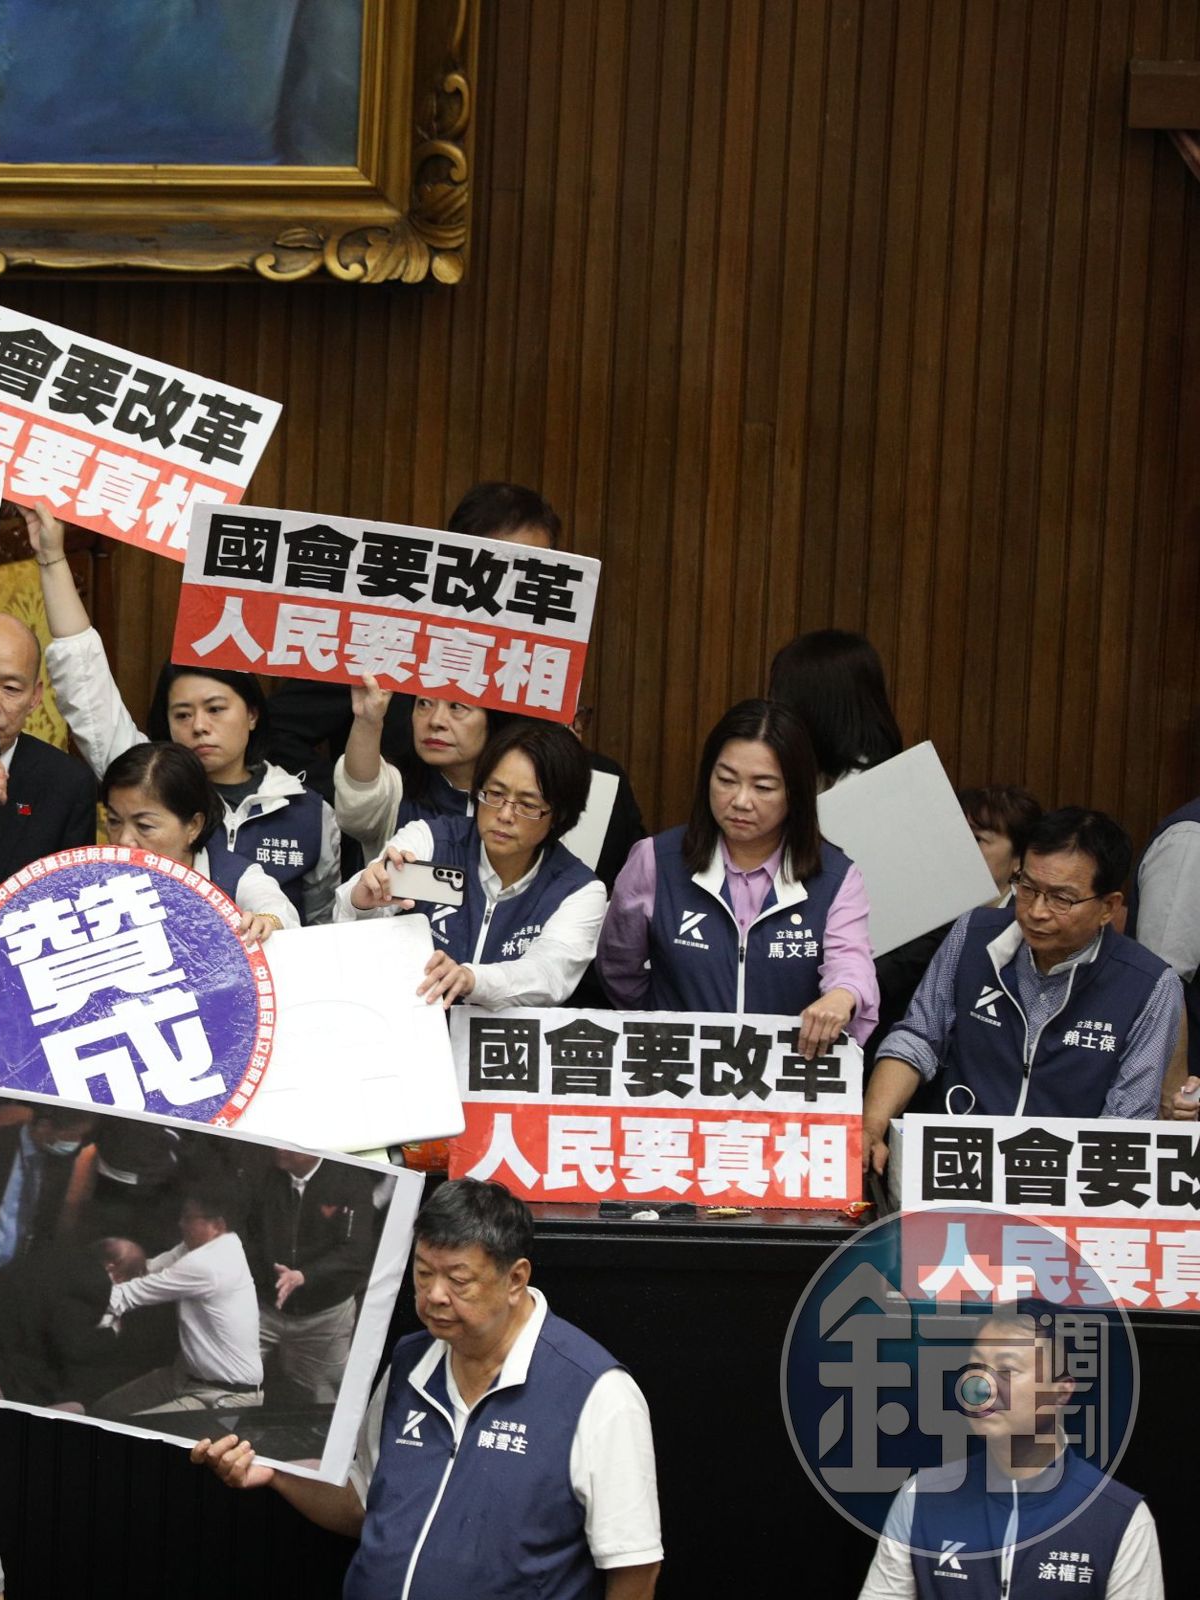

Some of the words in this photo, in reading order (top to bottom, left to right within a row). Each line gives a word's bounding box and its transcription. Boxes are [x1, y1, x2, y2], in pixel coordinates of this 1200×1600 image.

[203, 514, 583, 625] 國會要改革
[191, 596, 571, 711] 人民要真相
[262, 838, 298, 848] 立法委員
[256, 848, 304, 867] 邱若華
[776, 929, 813, 940] 立法委員
[768, 941, 819, 959] 馬文君
[1075, 1020, 1113, 1033] 立法委員
[1062, 1030, 1117, 1052] 賴士葆
[468, 1017, 848, 1102] 國會要改革
[466, 1113, 847, 1199] 人民要真相
[491, 1420, 527, 1434] 立法委員
[477, 1430, 528, 1455] 陳雪生
[1049, 1552, 1090, 1563] 立法委員
[1038, 1562, 1094, 1584] 涂權吉
